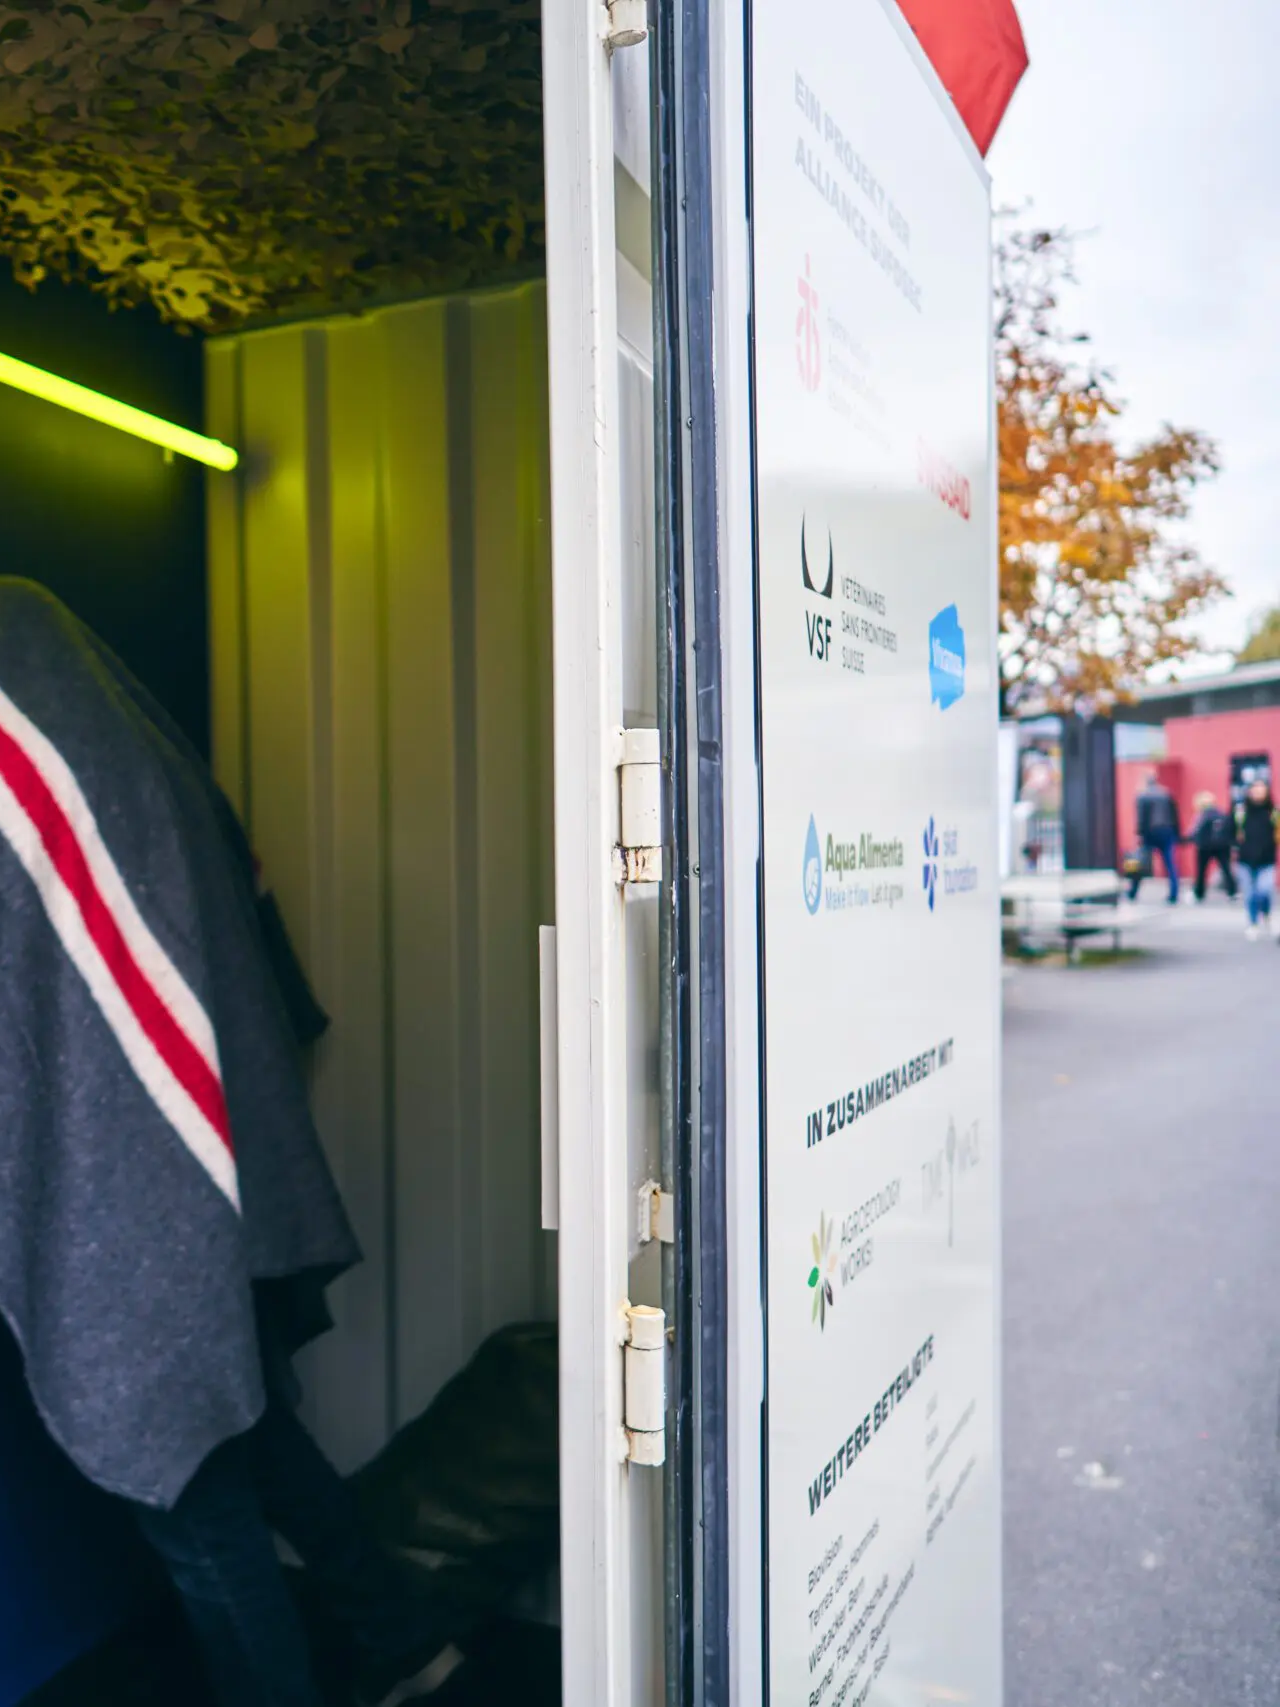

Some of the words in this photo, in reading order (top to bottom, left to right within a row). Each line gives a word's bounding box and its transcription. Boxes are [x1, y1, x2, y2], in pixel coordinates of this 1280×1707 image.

[794, 71, 821, 133] EIN
[824, 112, 885, 211] PROJEKT
[795, 136, 867, 246] ALLIANCE
[805, 609, 832, 662] VSF
[841, 610, 860, 639] SANS
[825, 831, 856, 881] Aqua
[858, 832, 903, 870] Alimenta
[825, 887, 846, 911] Make
[806, 1107, 823, 1150] IN
[826, 1051, 936, 1138] ZUSAMMENARBEIT
[938, 1036, 955, 1069] MIT
[808, 1411, 872, 1517] WEITERE
[872, 1332, 935, 1433] BETEILIGTE
[808, 1534, 843, 1595] Biovision
[808, 1586, 834, 1632] Terres
